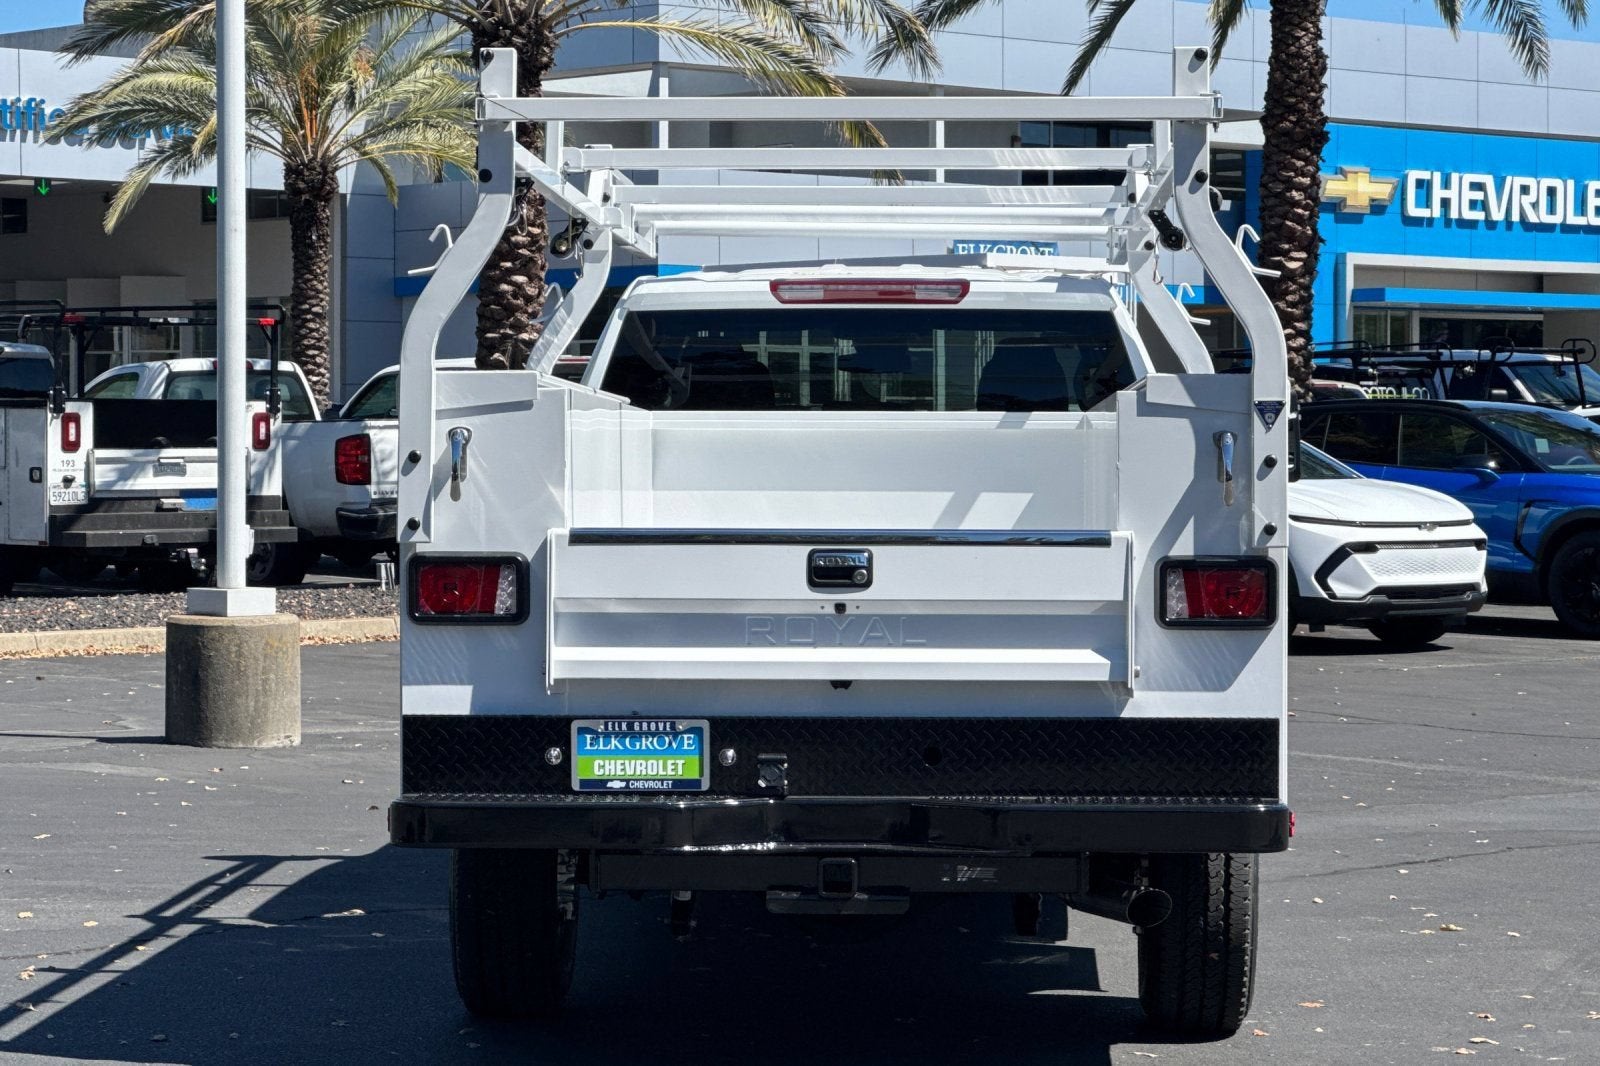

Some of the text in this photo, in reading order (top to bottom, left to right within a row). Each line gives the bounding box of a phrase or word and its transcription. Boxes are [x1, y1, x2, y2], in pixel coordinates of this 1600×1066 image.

[61, 459, 75, 468] 193
[744, 615, 927, 646] ROYAL
[608, 721, 671, 731] ELK GROVE
[584, 734, 696, 750] ELK GROVE
[593, 759, 686, 777] CHEVROLET
[629, 780, 673, 789] CHEVROLET
